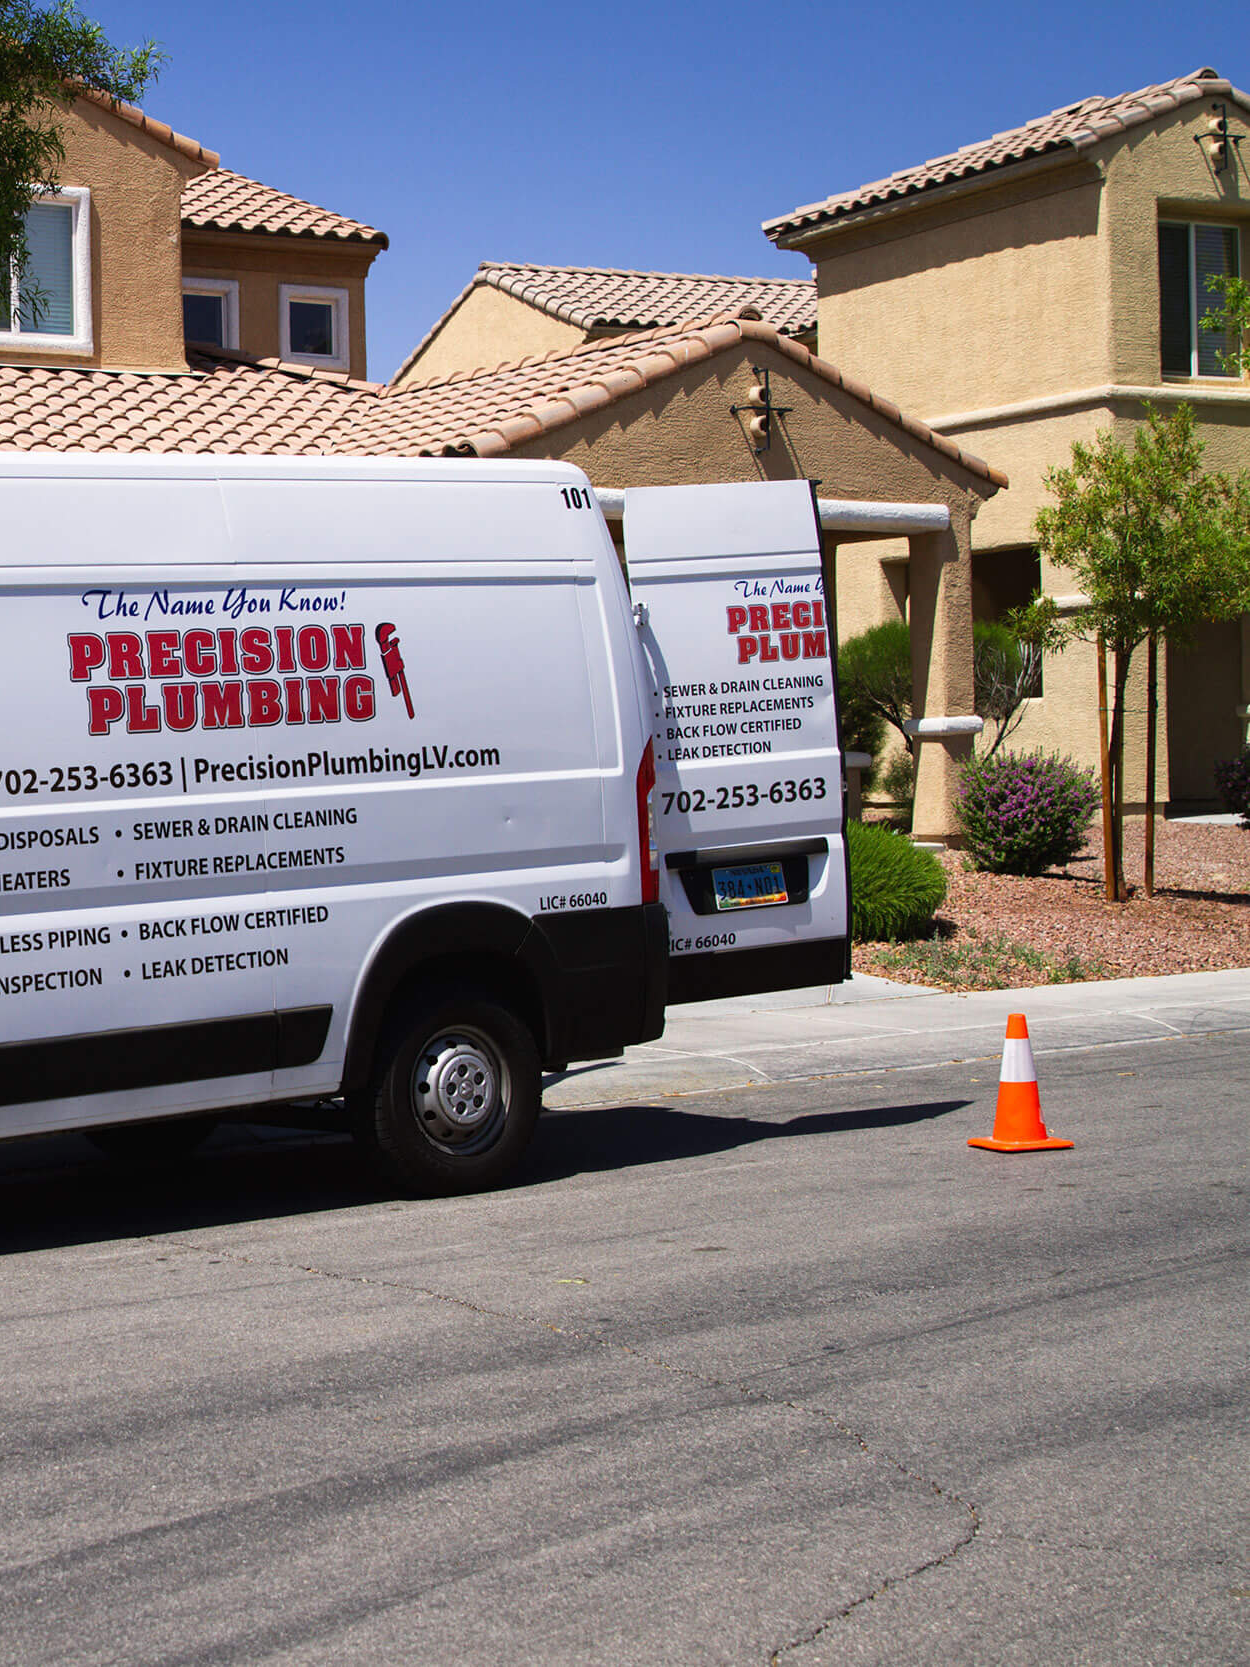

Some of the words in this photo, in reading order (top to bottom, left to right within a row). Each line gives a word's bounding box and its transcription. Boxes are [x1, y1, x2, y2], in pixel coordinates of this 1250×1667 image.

[561, 486, 592, 510] 101
[82, 589, 141, 620] The
[144, 593, 216, 622] Name
[221, 587, 272, 616] You
[278, 590, 347, 612] Know!
[734, 580, 766, 598] The
[770, 578, 811, 598] Name
[726, 600, 825, 634] PRECI
[66, 623, 367, 683] PRECISION
[737, 629, 827, 664] PLUM
[663, 684, 706, 698] SEWER
[709, 682, 718, 695] &
[721, 680, 760, 694] DRAIN
[762, 675, 824, 691] CLEANING
[86, 674, 377, 737] PLUMBING
[665, 704, 717, 719] FIXTURE
[719, 696, 815, 715] REPLACEMENTS
[666, 726, 700, 740] BACK
[702, 723, 738, 737] FLOW
[740, 718, 802, 734] CERTIFIED
[194, 744, 501, 784] PrecisionPlumbingLV.com
[667, 747, 700, 761] LEAK
[702, 741, 772, 758] DETECTION
[661, 777, 827, 816] 702-253-6363
[133, 818, 194, 841] SEWER
[197, 818, 210, 836] &
[214, 814, 268, 835] DRAIN
[273, 807, 358, 830] CLEANING
[135, 858, 209, 881] FIXTURE
[213, 847, 345, 874] REPLACEMENTS
[539, 895, 567, 912] LIC#
[569, 892, 608, 909] 66040
[49, 926, 111, 950] PIPING
[139, 919, 187, 941] BACK
[191, 914, 240, 936] FLOW
[244, 906, 329, 930] CERTIFIED
[670, 937, 692, 952] IC#
[695, 932, 736, 949] 66040
[141, 958, 187, 980] LEAK
[191, 948, 289, 975] DETECTION
